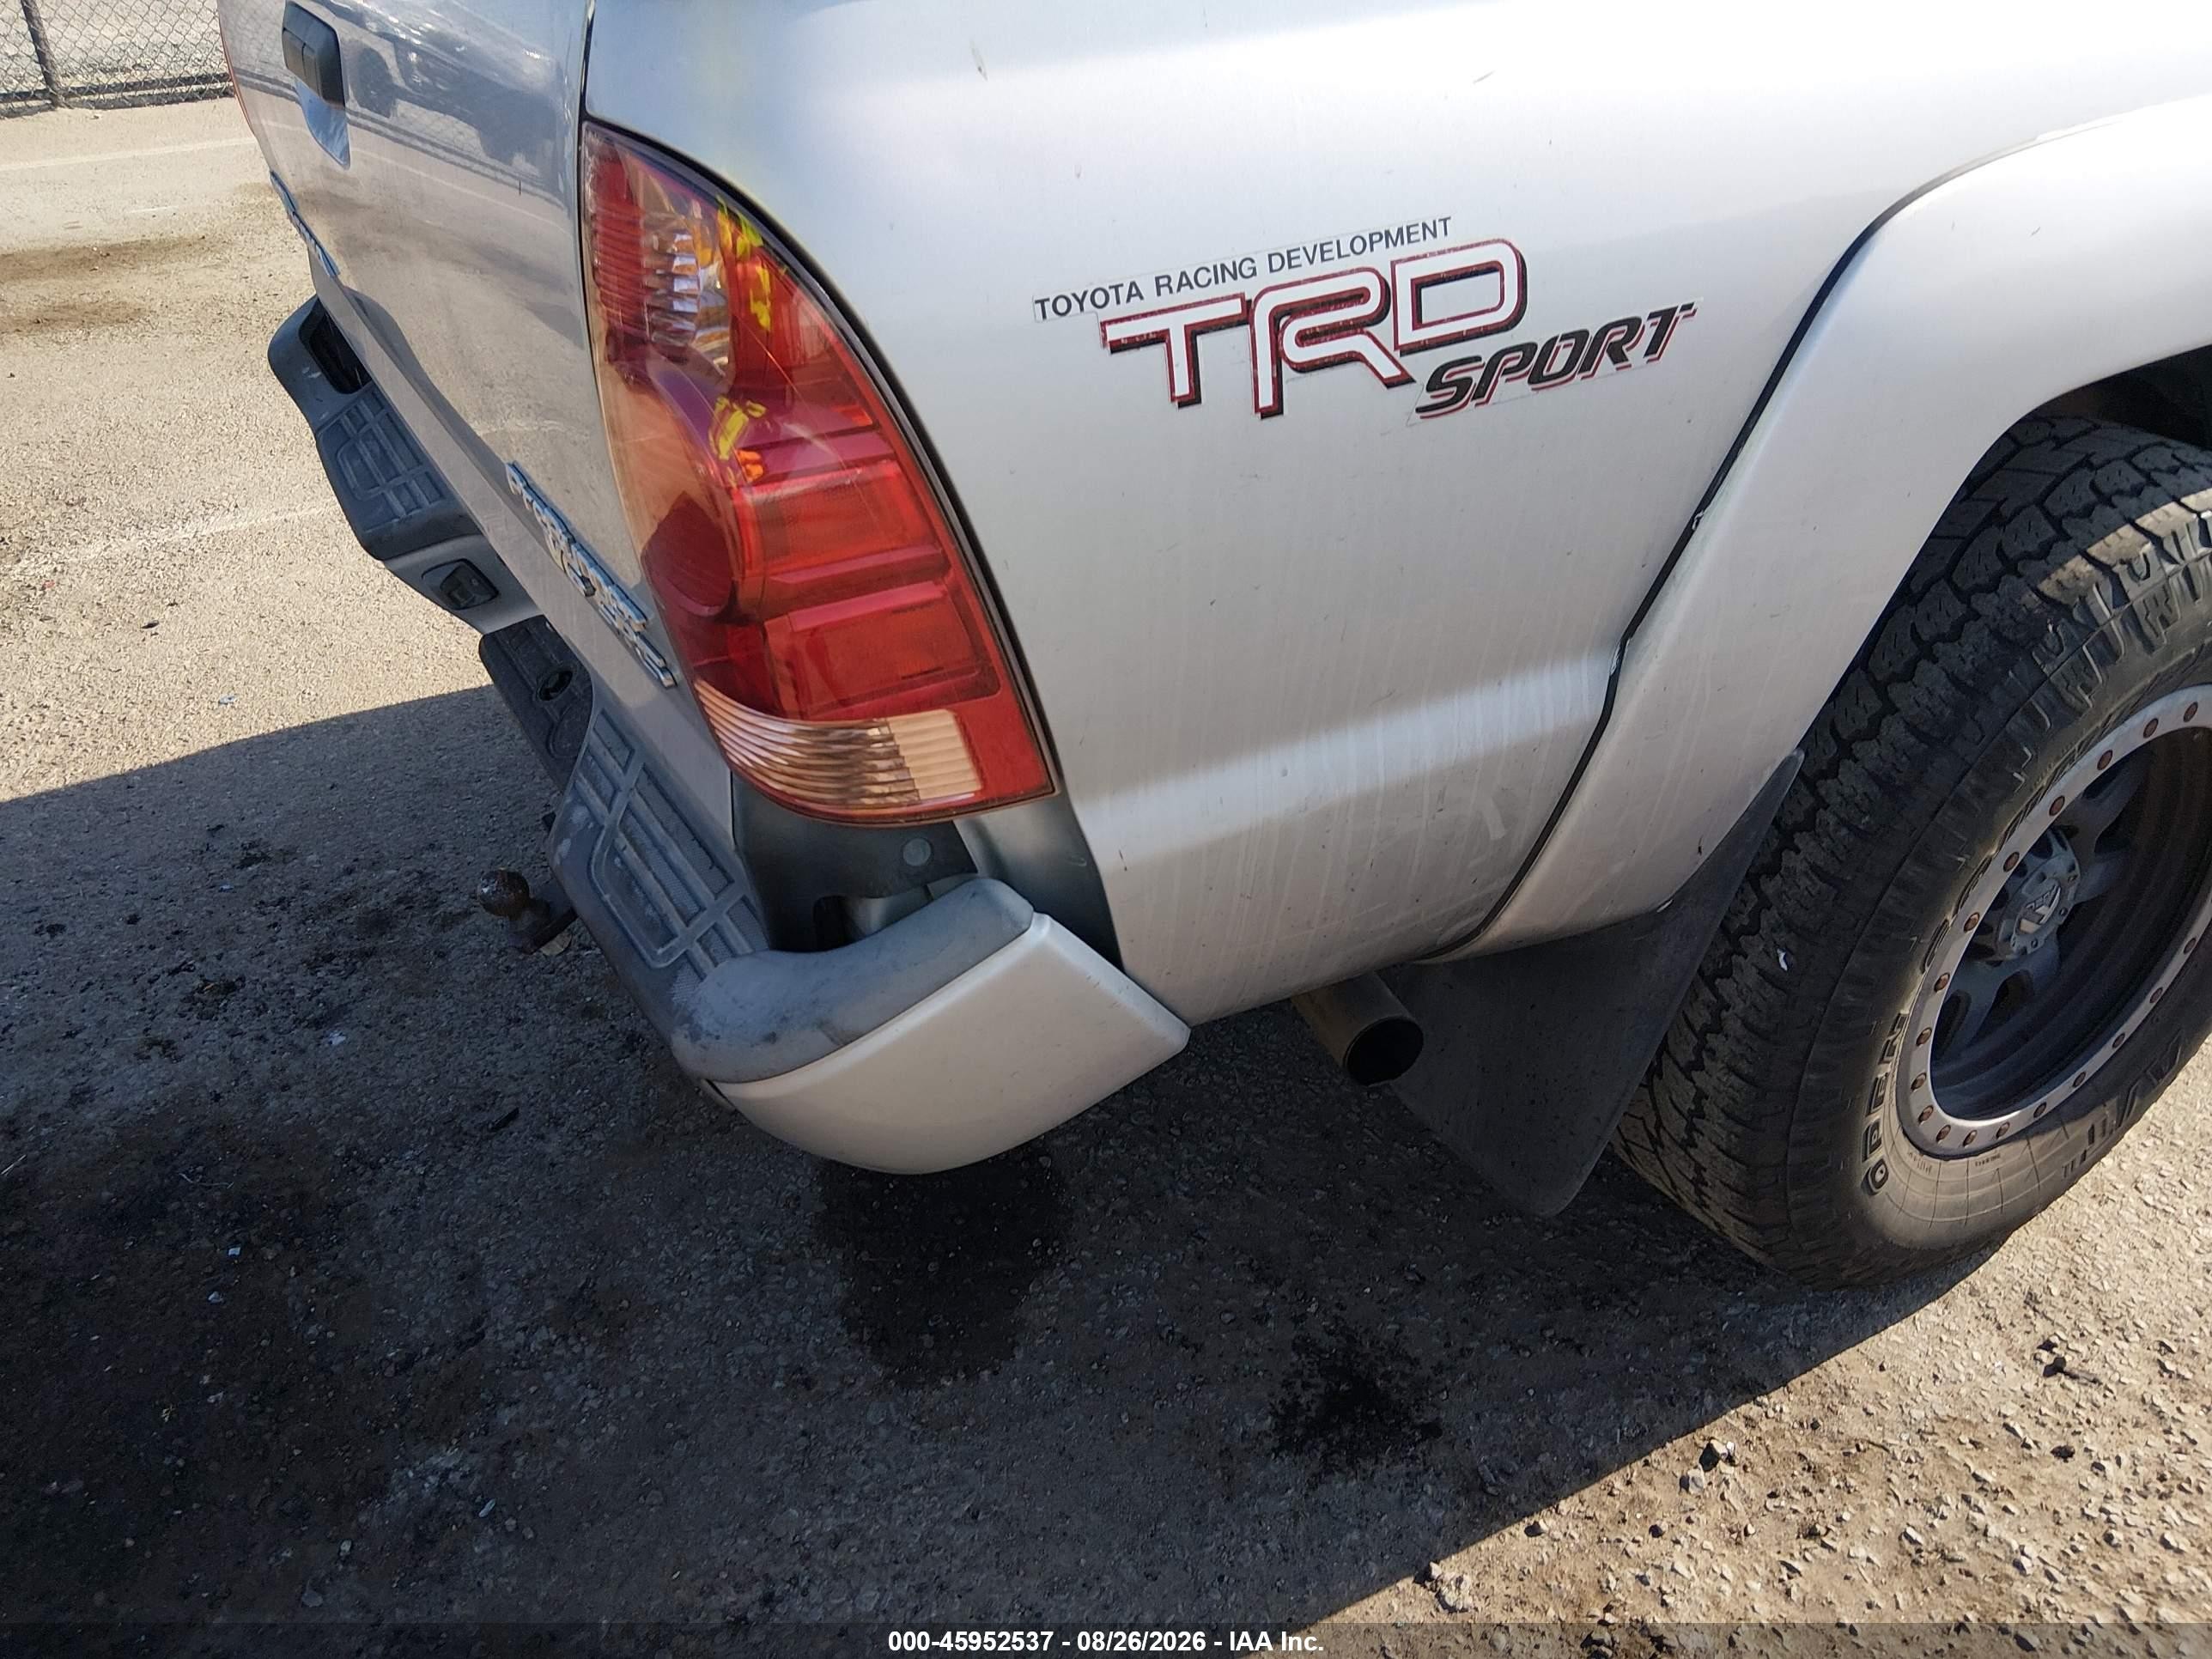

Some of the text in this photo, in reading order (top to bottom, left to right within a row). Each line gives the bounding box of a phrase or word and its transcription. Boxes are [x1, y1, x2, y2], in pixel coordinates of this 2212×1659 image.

[1034, 216, 1451, 320] TOYOTA RACING DEVELOPMENT
[1099, 238, 1528, 420] TRD
[1415, 301, 1698, 419] SPORT
